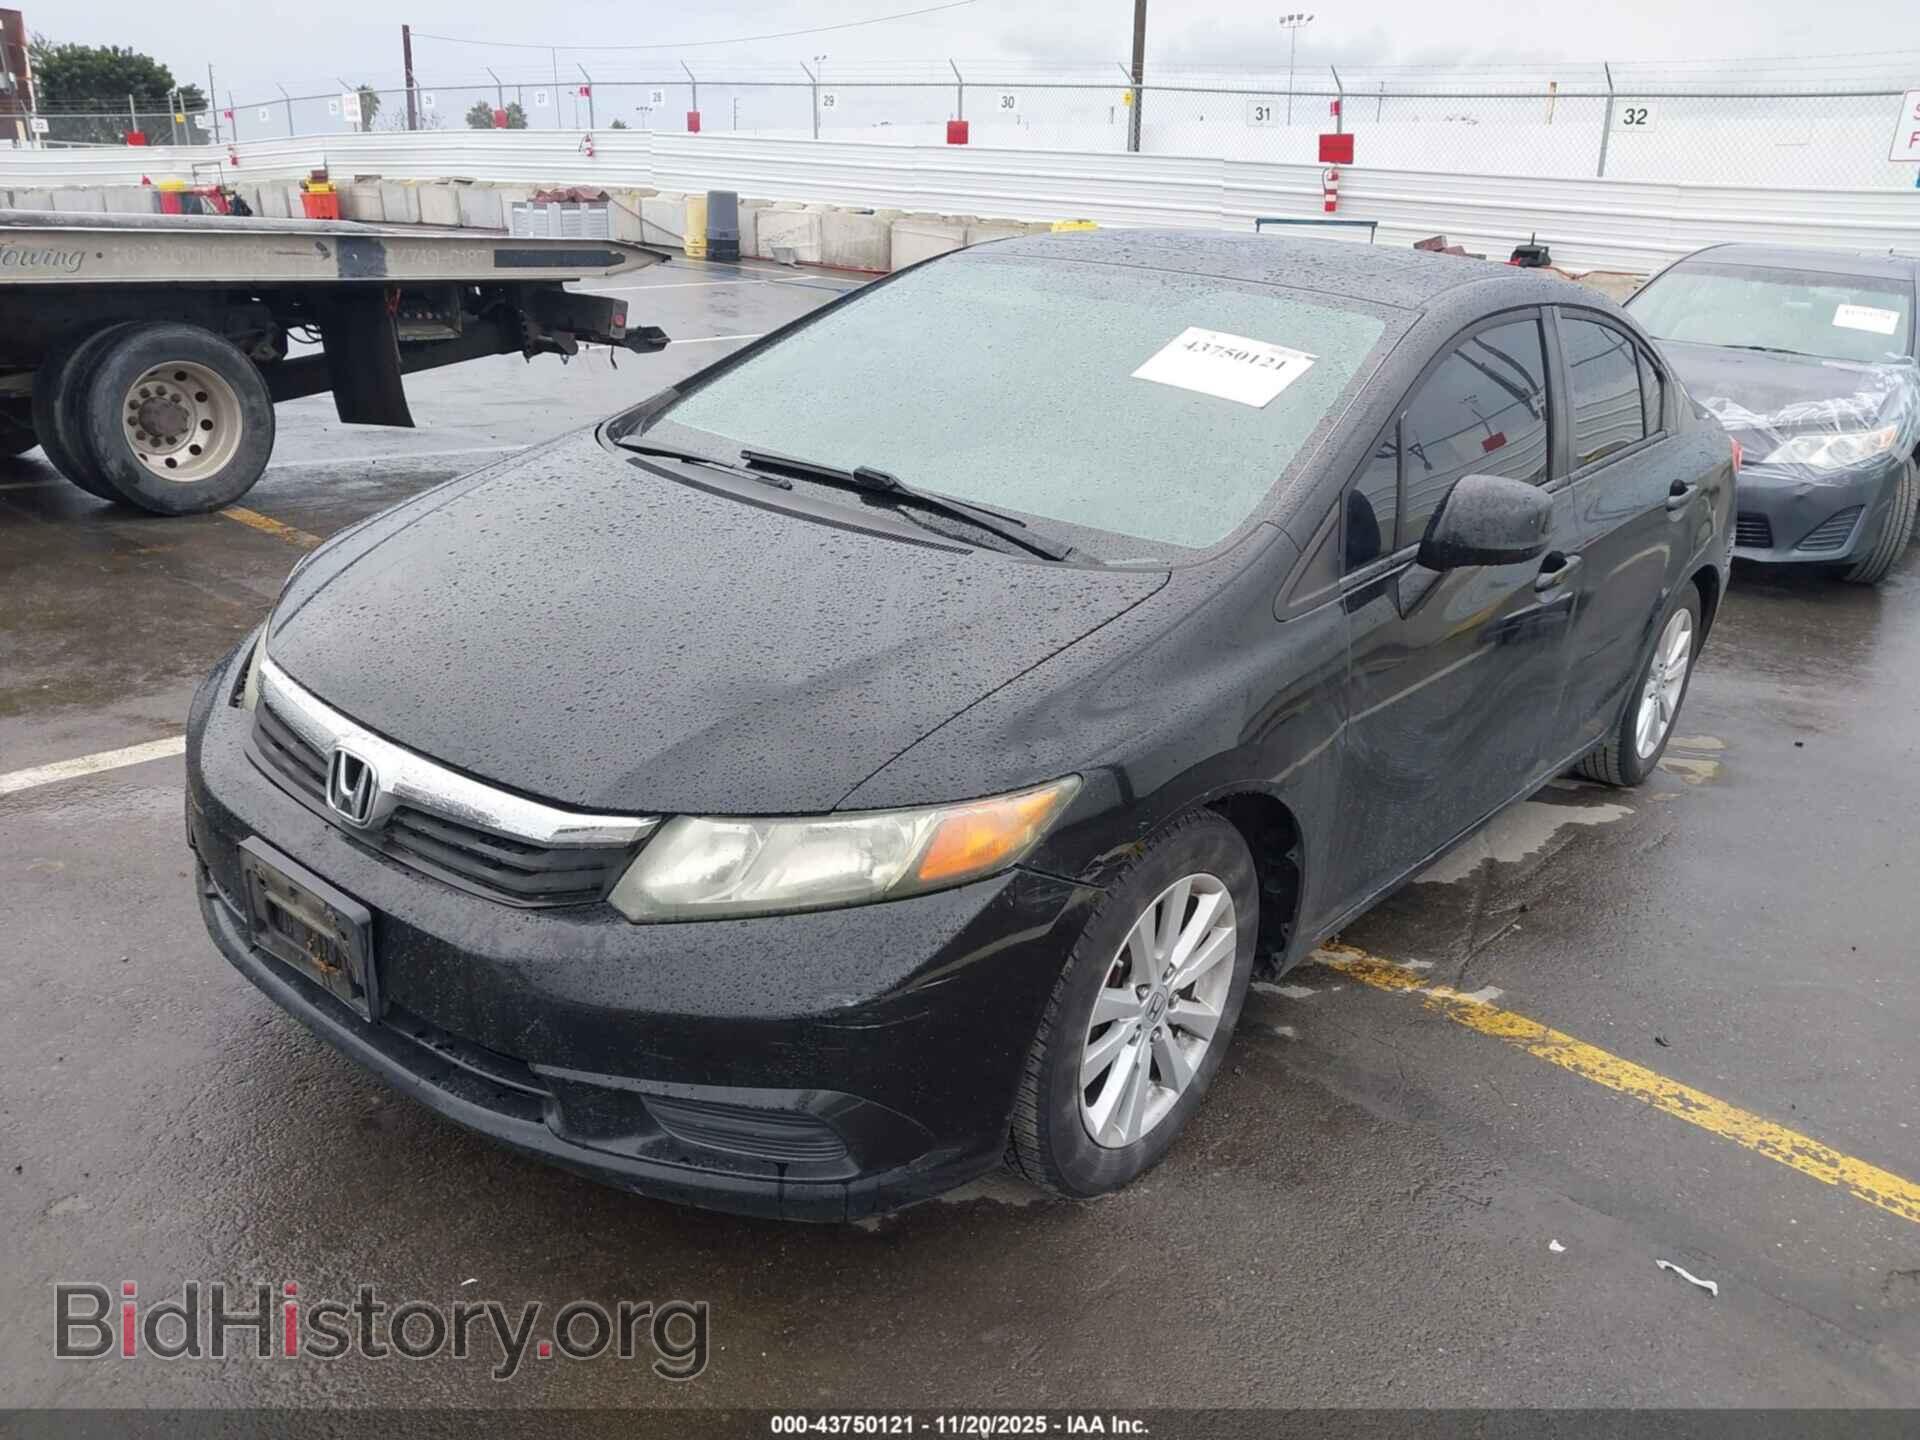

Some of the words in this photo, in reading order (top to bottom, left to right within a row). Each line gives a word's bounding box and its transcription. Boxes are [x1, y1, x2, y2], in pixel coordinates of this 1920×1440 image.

[823, 95, 835, 107] 29
[1001, 95, 1015, 109] 30
[1255, 106, 1271, 121] 31
[1623, 108, 1648, 125] 32
[1184, 339, 1287, 371] 43750121
